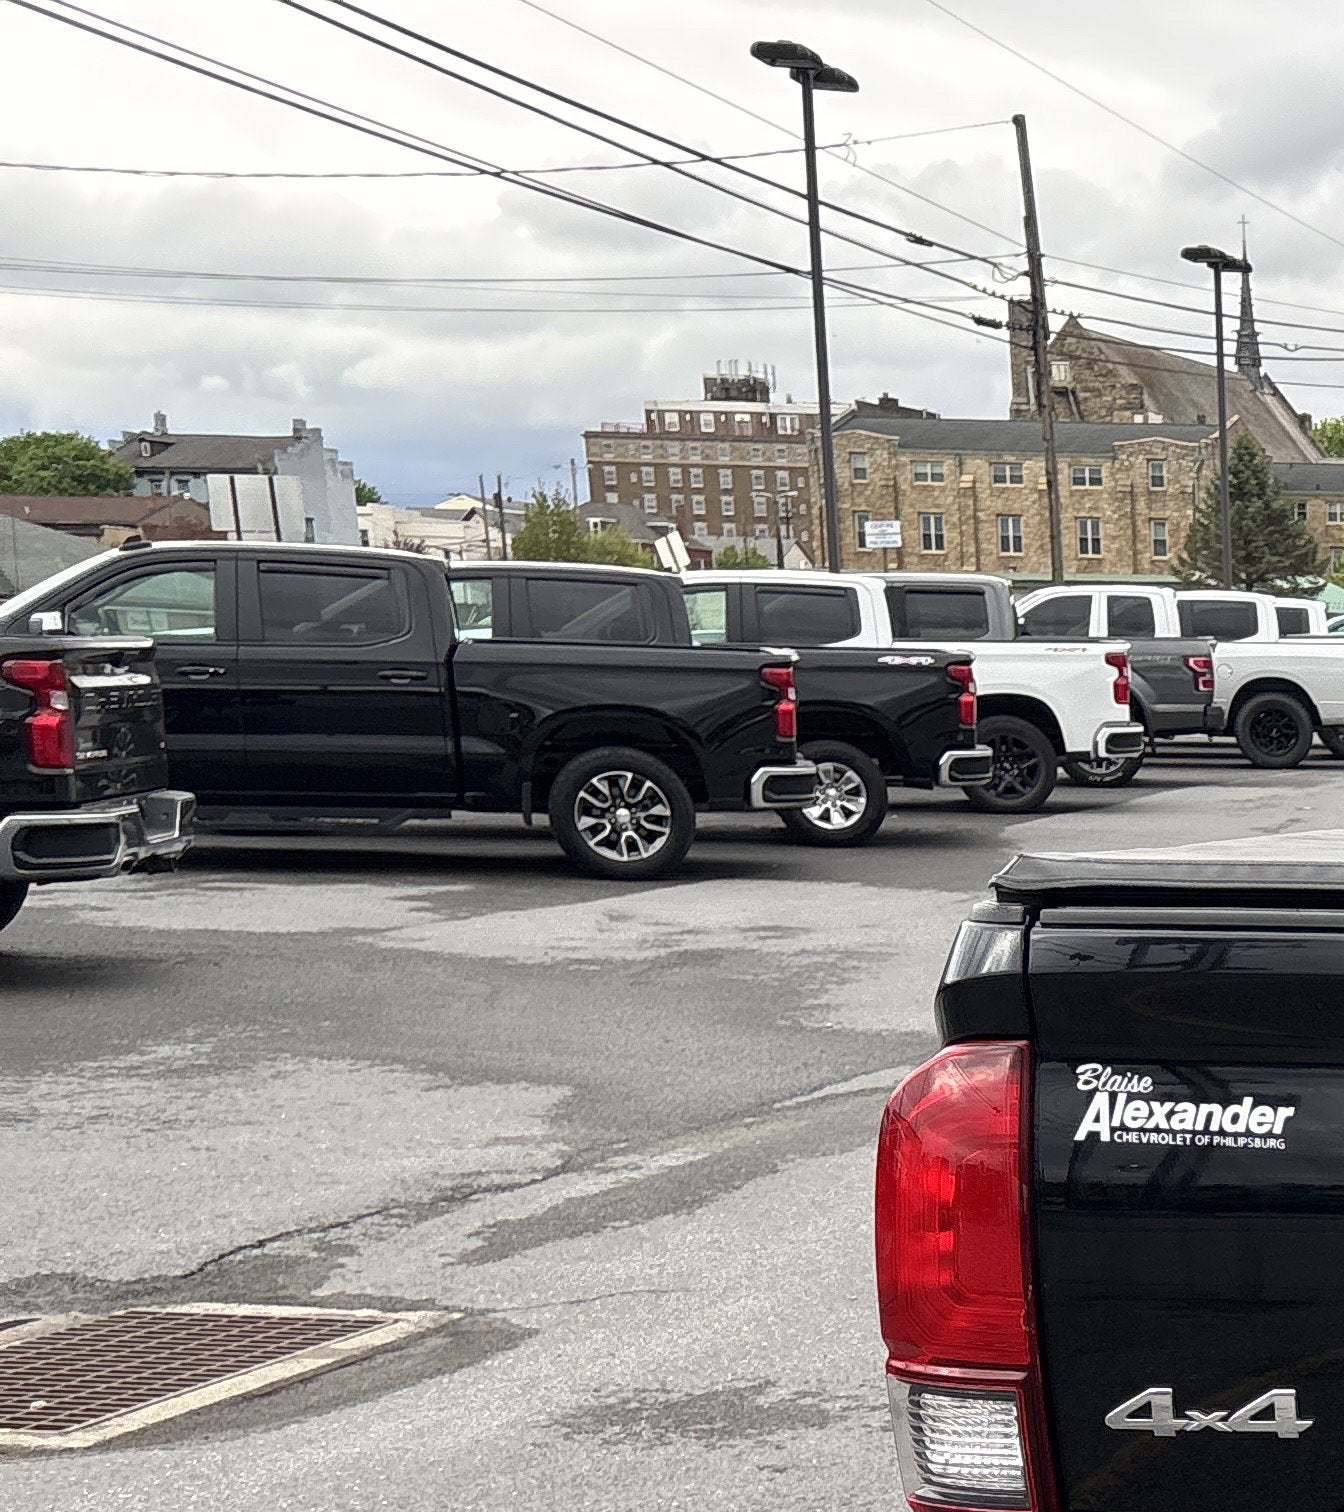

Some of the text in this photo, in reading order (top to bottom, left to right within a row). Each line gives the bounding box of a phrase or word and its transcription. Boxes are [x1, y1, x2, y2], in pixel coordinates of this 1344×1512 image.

[1075, 1063, 1154, 1092] Blaise
[1073, 1091, 1295, 1142] Alexander
[1113, 1130, 1286, 1150] CHEVROLET OF PHILIPSBURG
